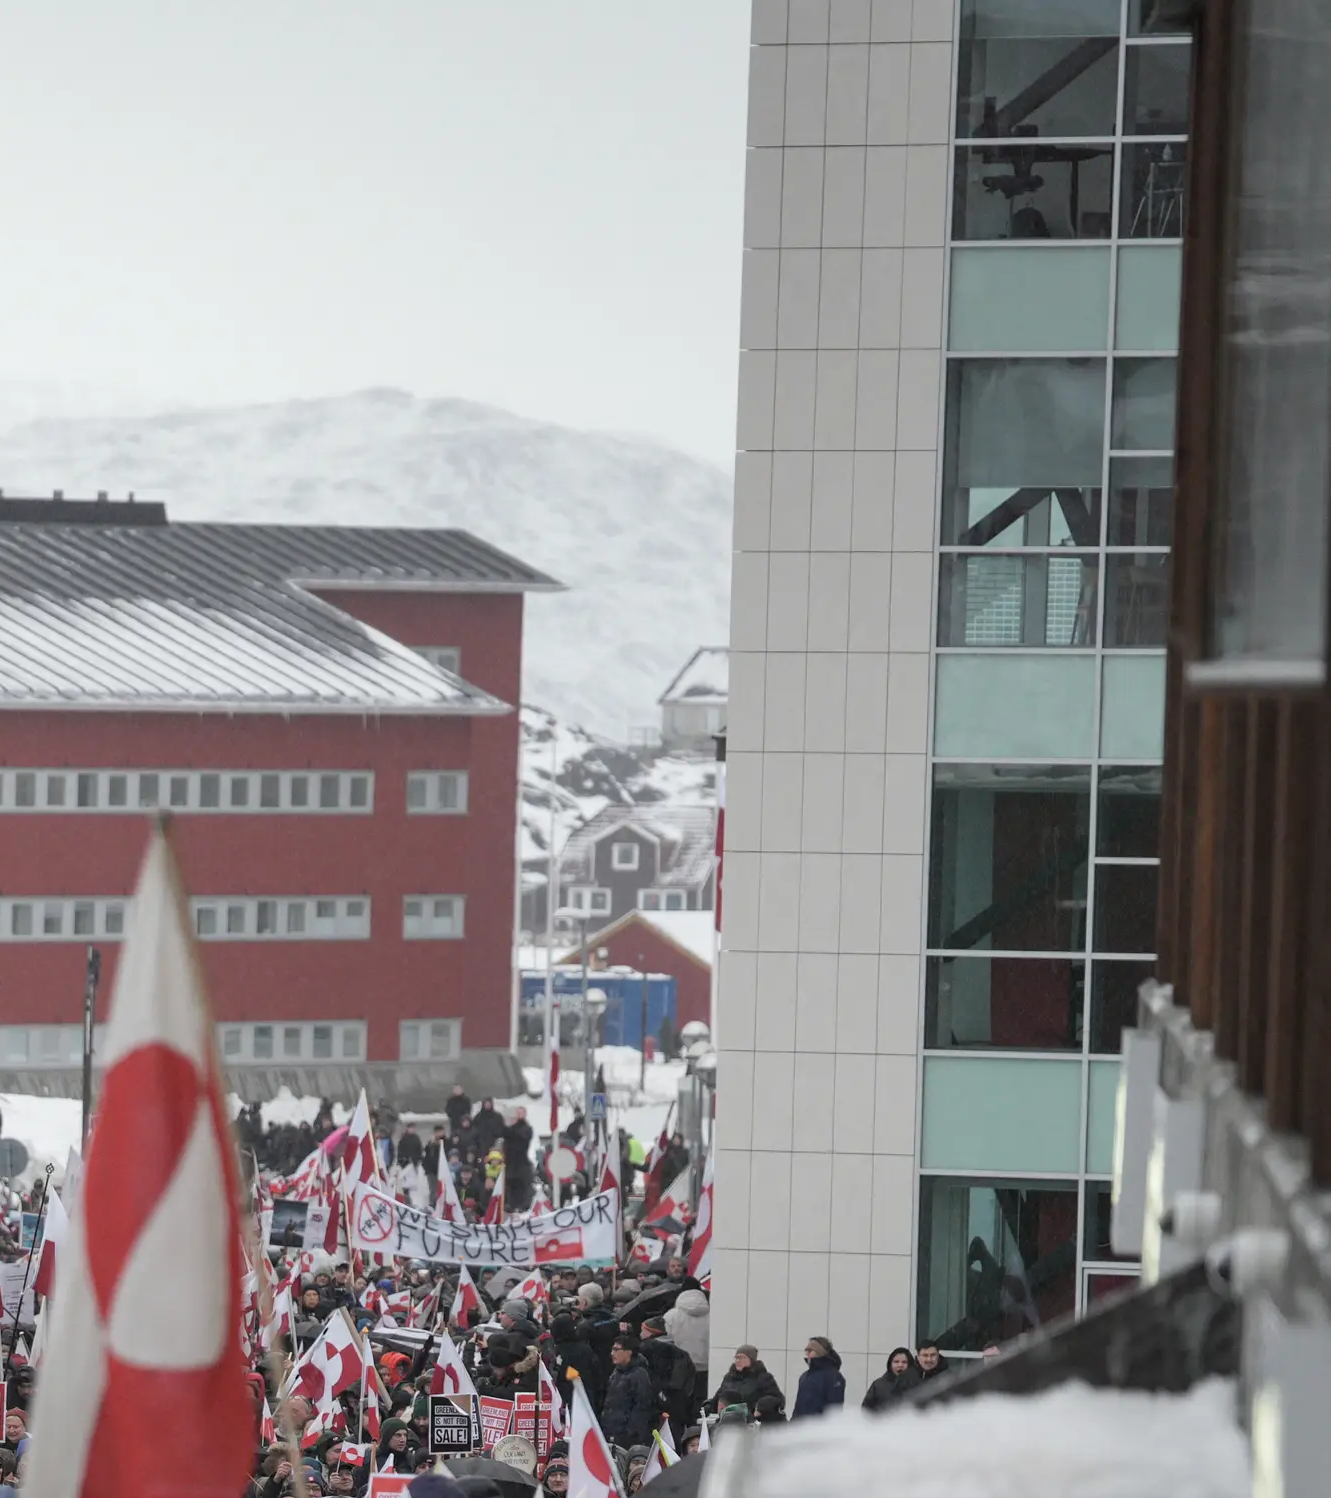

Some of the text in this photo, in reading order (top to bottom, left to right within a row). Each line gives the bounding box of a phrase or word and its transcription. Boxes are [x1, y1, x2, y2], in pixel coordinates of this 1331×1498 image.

[396, 1194, 613, 1242] WE SHAPE OUR
[395, 1220, 530, 1264] FUTURE
[435, 1417, 467, 1426] IS NOT FOR
[435, 1428, 467, 1444] SALE!
